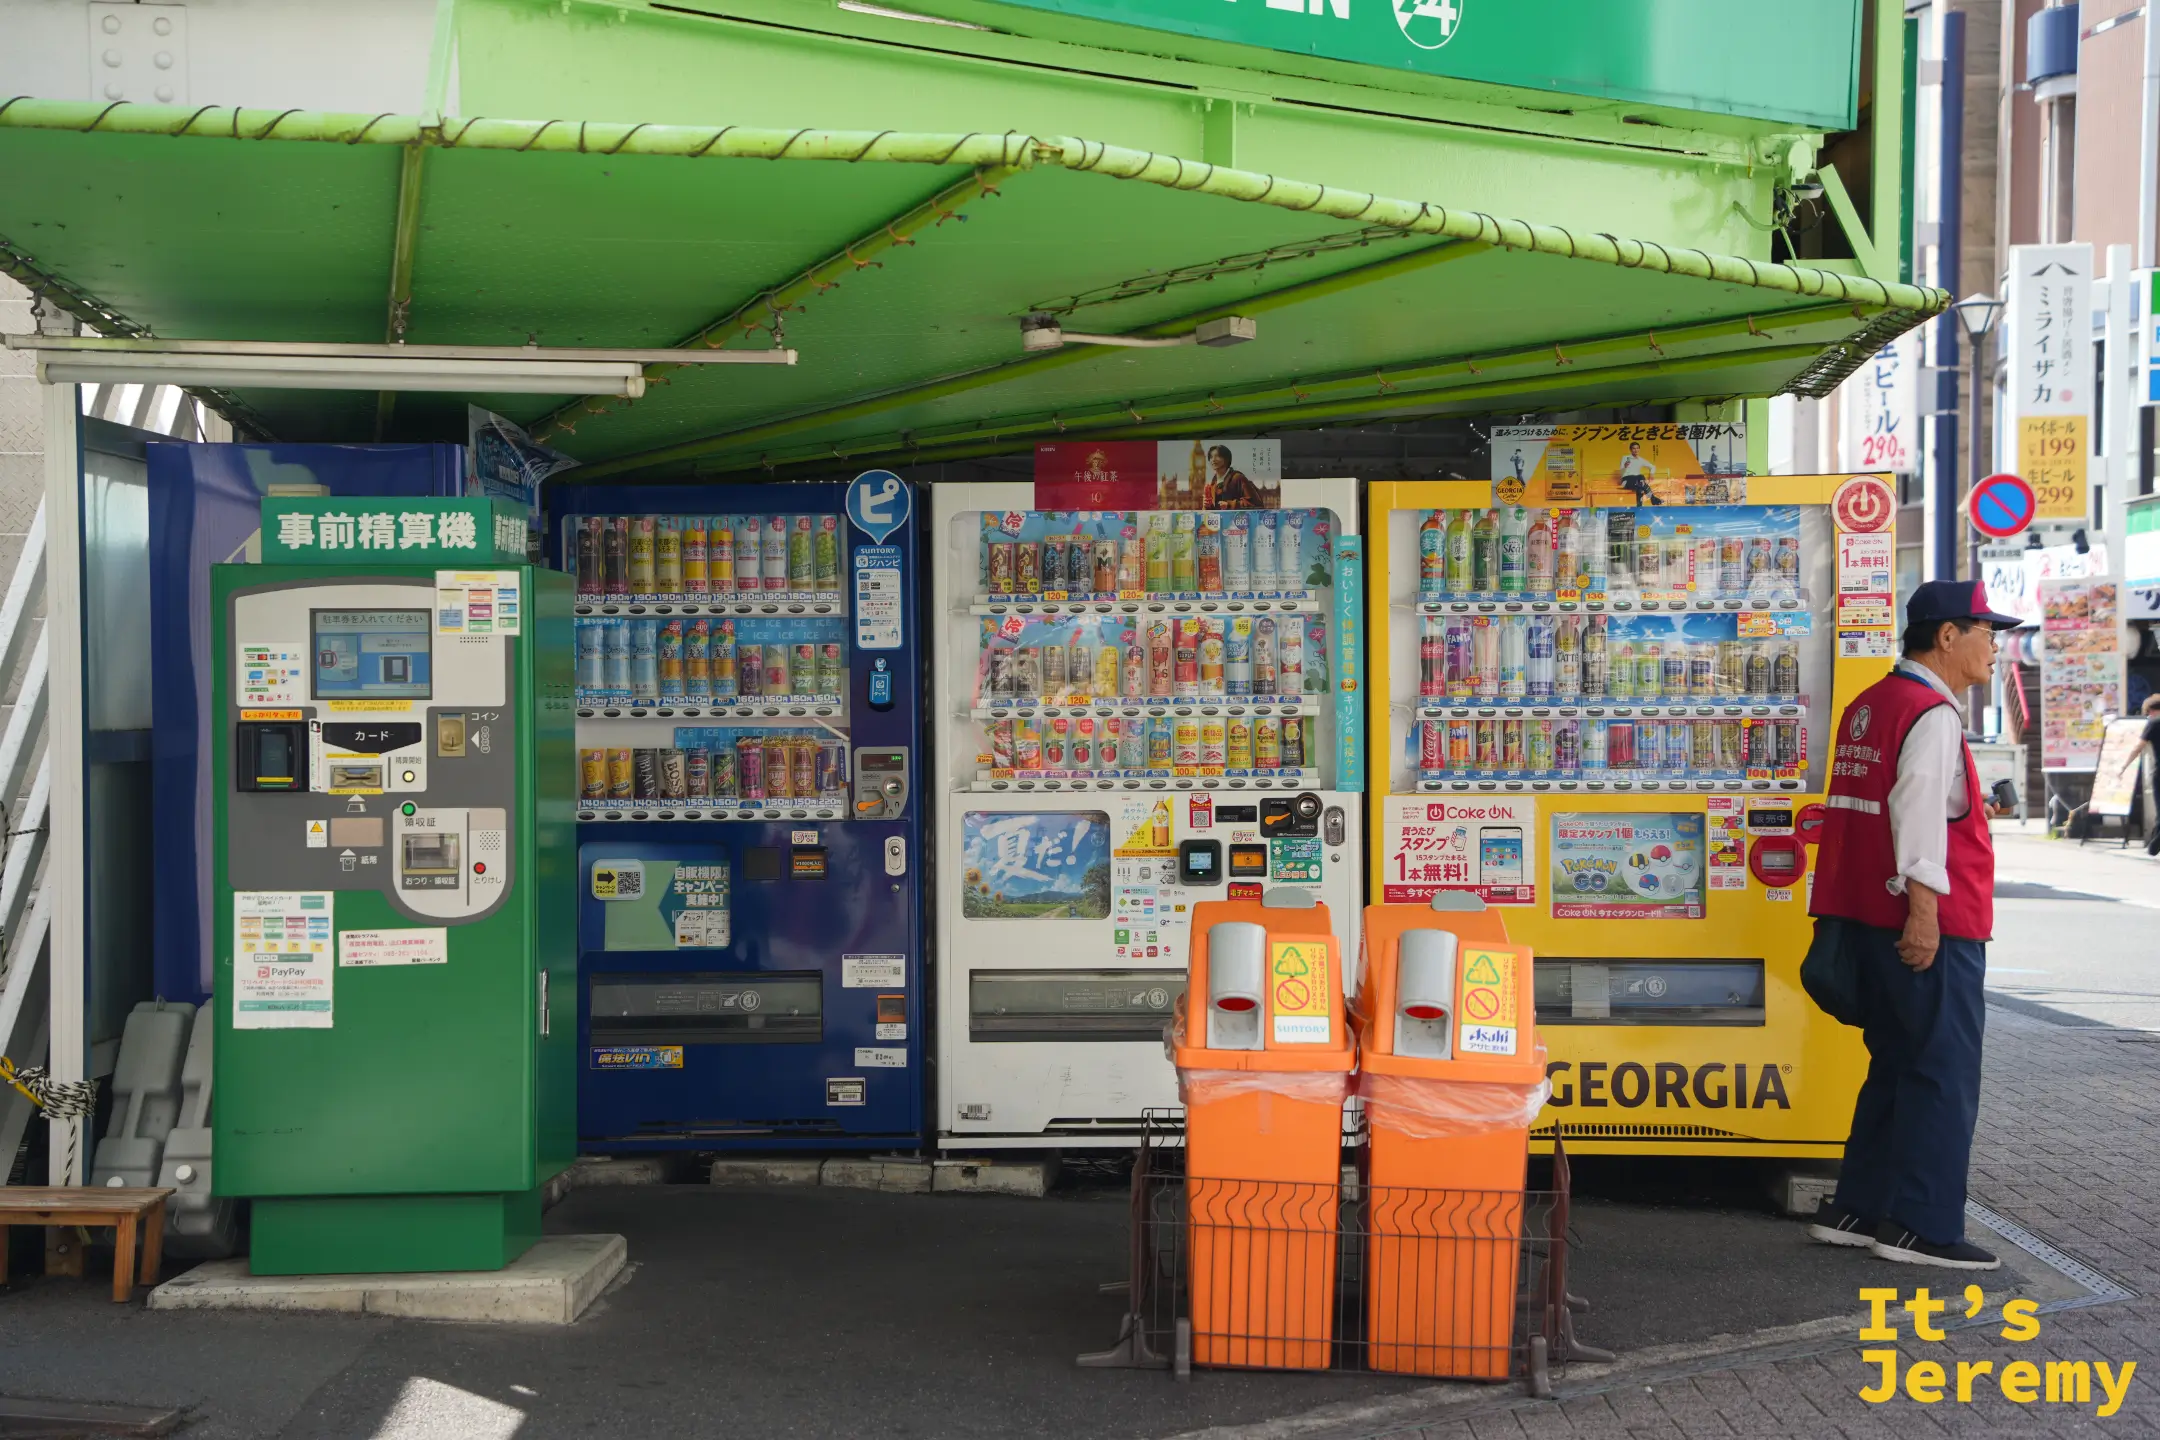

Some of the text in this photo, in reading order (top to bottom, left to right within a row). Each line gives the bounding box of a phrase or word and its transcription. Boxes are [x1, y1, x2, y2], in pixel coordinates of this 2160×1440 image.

[2032, 285, 2055, 404] ミライザカ
[1571, 424, 1745, 442] ジブンをときどき圏外へ。
[1074, 470, 1118, 482] 午後の紅茶
[2027, 468, 2075, 486] 生ビール
[1497, 486, 1524, 494] GEORGIA
[859, 478, 900, 525] ピ
[277, 511, 477, 550] 事前精算機
[494, 513, 527, 556] 事前精算機
[868, 558, 901, 568] ジハンピ
[1841, 549, 1889, 568] 1本無料!
[322, 614, 424, 625] 駐車券を入れてください
[741, 620, 831, 628] ICE ICE ICE ICE
[754, 631, 843, 640] ICE ICE ICE ICE
[1583, 652, 1606, 662] BLACK
[471, 712, 500, 721] コイン
[355, 730, 390, 742] カード
[678, 728, 818, 736] ICE ICE ICE ICE ICE ICE
[395, 756, 422, 765] 精算開始
[1446, 804, 1513, 819] Coke ON
[404, 817, 436, 828] 領収証
[1753, 814, 1788, 824] 販売中
[1401, 826, 1436, 836] 買うたび
[1558, 827, 1671, 840] 限定スタンプ1個もらえる!
[979, 816, 1091, 882] 夏だ!
[1400, 836, 1450, 851] スタンプ
[360, 855, 378, 865] 紙幣
[1393, 852, 1469, 882] 1本無料!
[405, 876, 456, 885] おつり・領収証
[474, 876, 502, 884] とりけし
[1572, 871, 1608, 891] GO
[1230, 888, 1261, 897] 電子マネー
[686, 893, 723, 906] 実施中!
[1557, 908, 1662, 918] Coke ON 今すぐダウンロード!!
[271, 967, 306, 977] PayPay
[1276, 1024, 1328, 1034] SUNTORY
[1469, 1028, 1510, 1045] Asahi
[1468, 1042, 1508, 1053] アサヒ飲料
